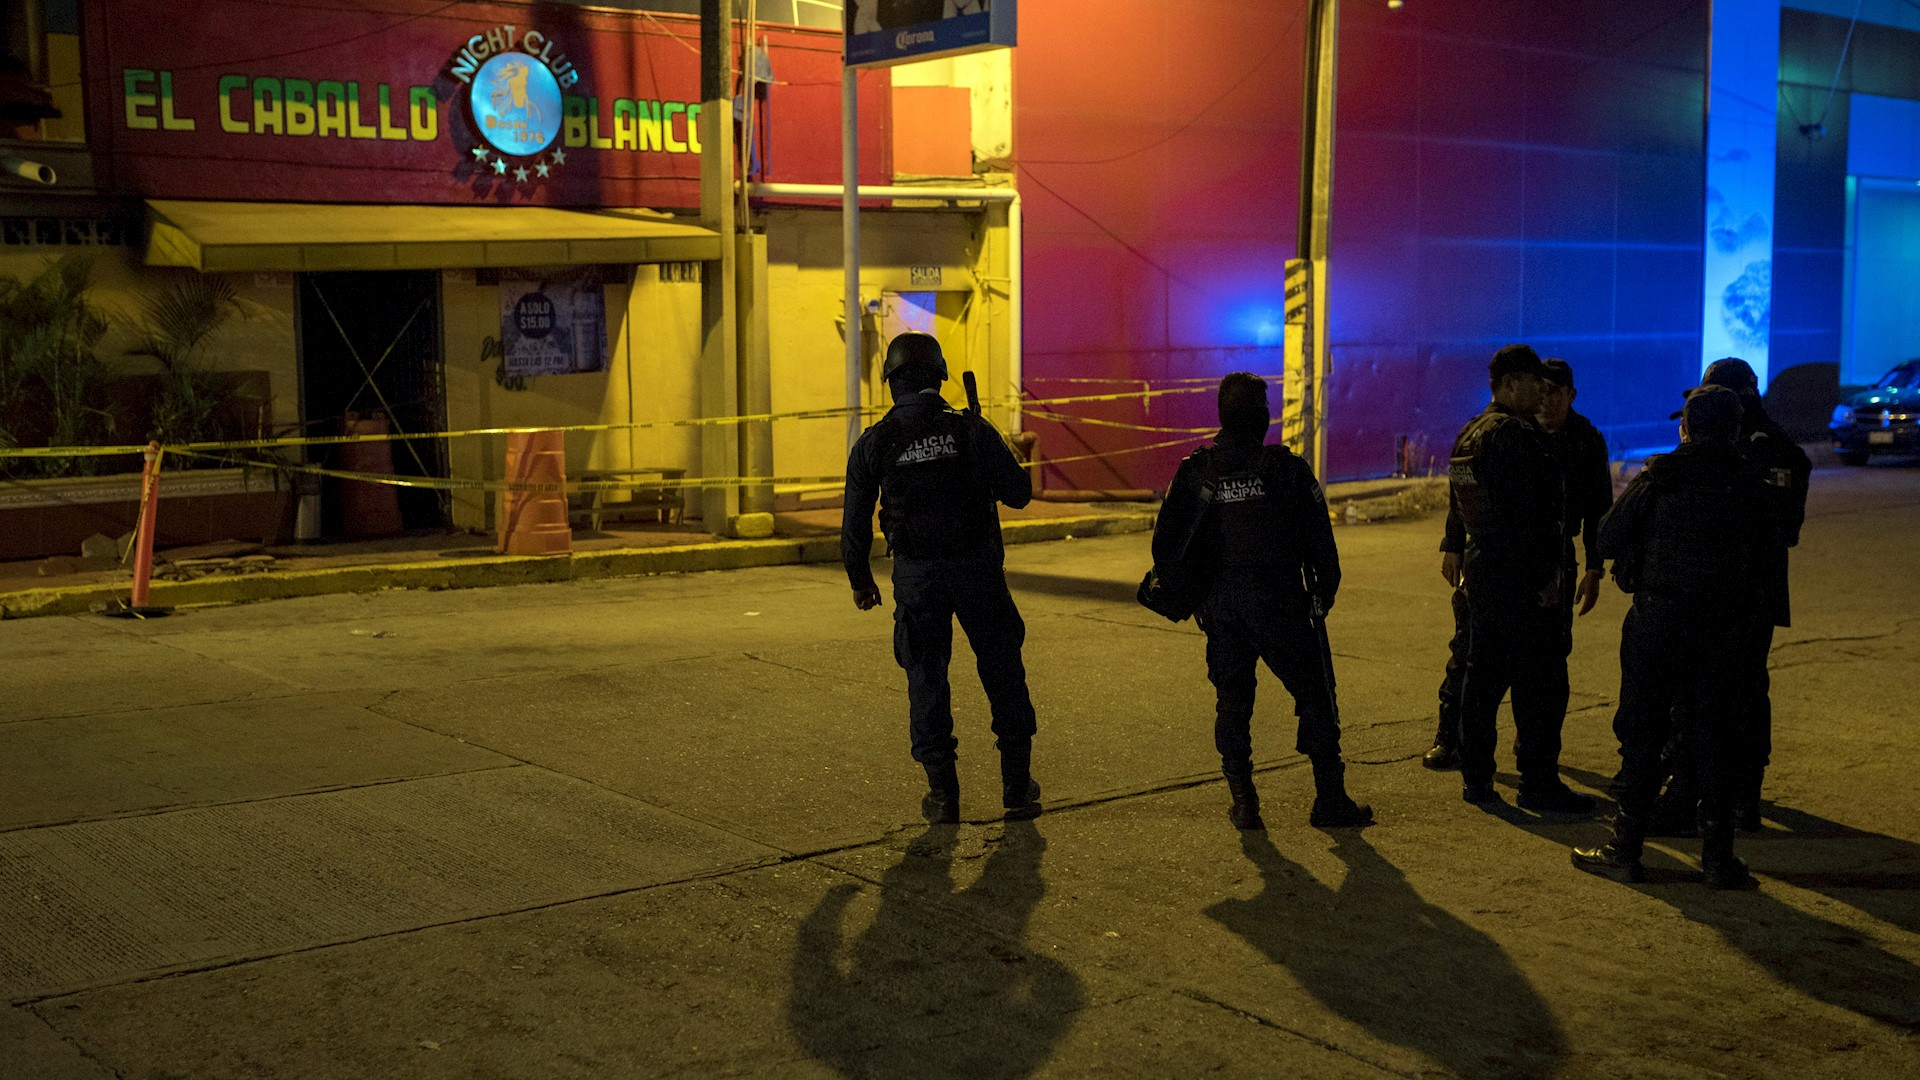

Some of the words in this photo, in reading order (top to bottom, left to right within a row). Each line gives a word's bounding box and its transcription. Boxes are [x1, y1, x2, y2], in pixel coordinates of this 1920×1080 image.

[895, 30, 935, 50] Corona
[451, 25, 516, 83] NIGHT
[523, 30, 580, 89] CLUB
[123, 68, 196, 131] EL
[218, 74, 439, 141] CABALLO
[912, 267, 940, 279] SALIDA
[520, 302, 526, 314] A
[528, 302, 550, 314] SOLO
